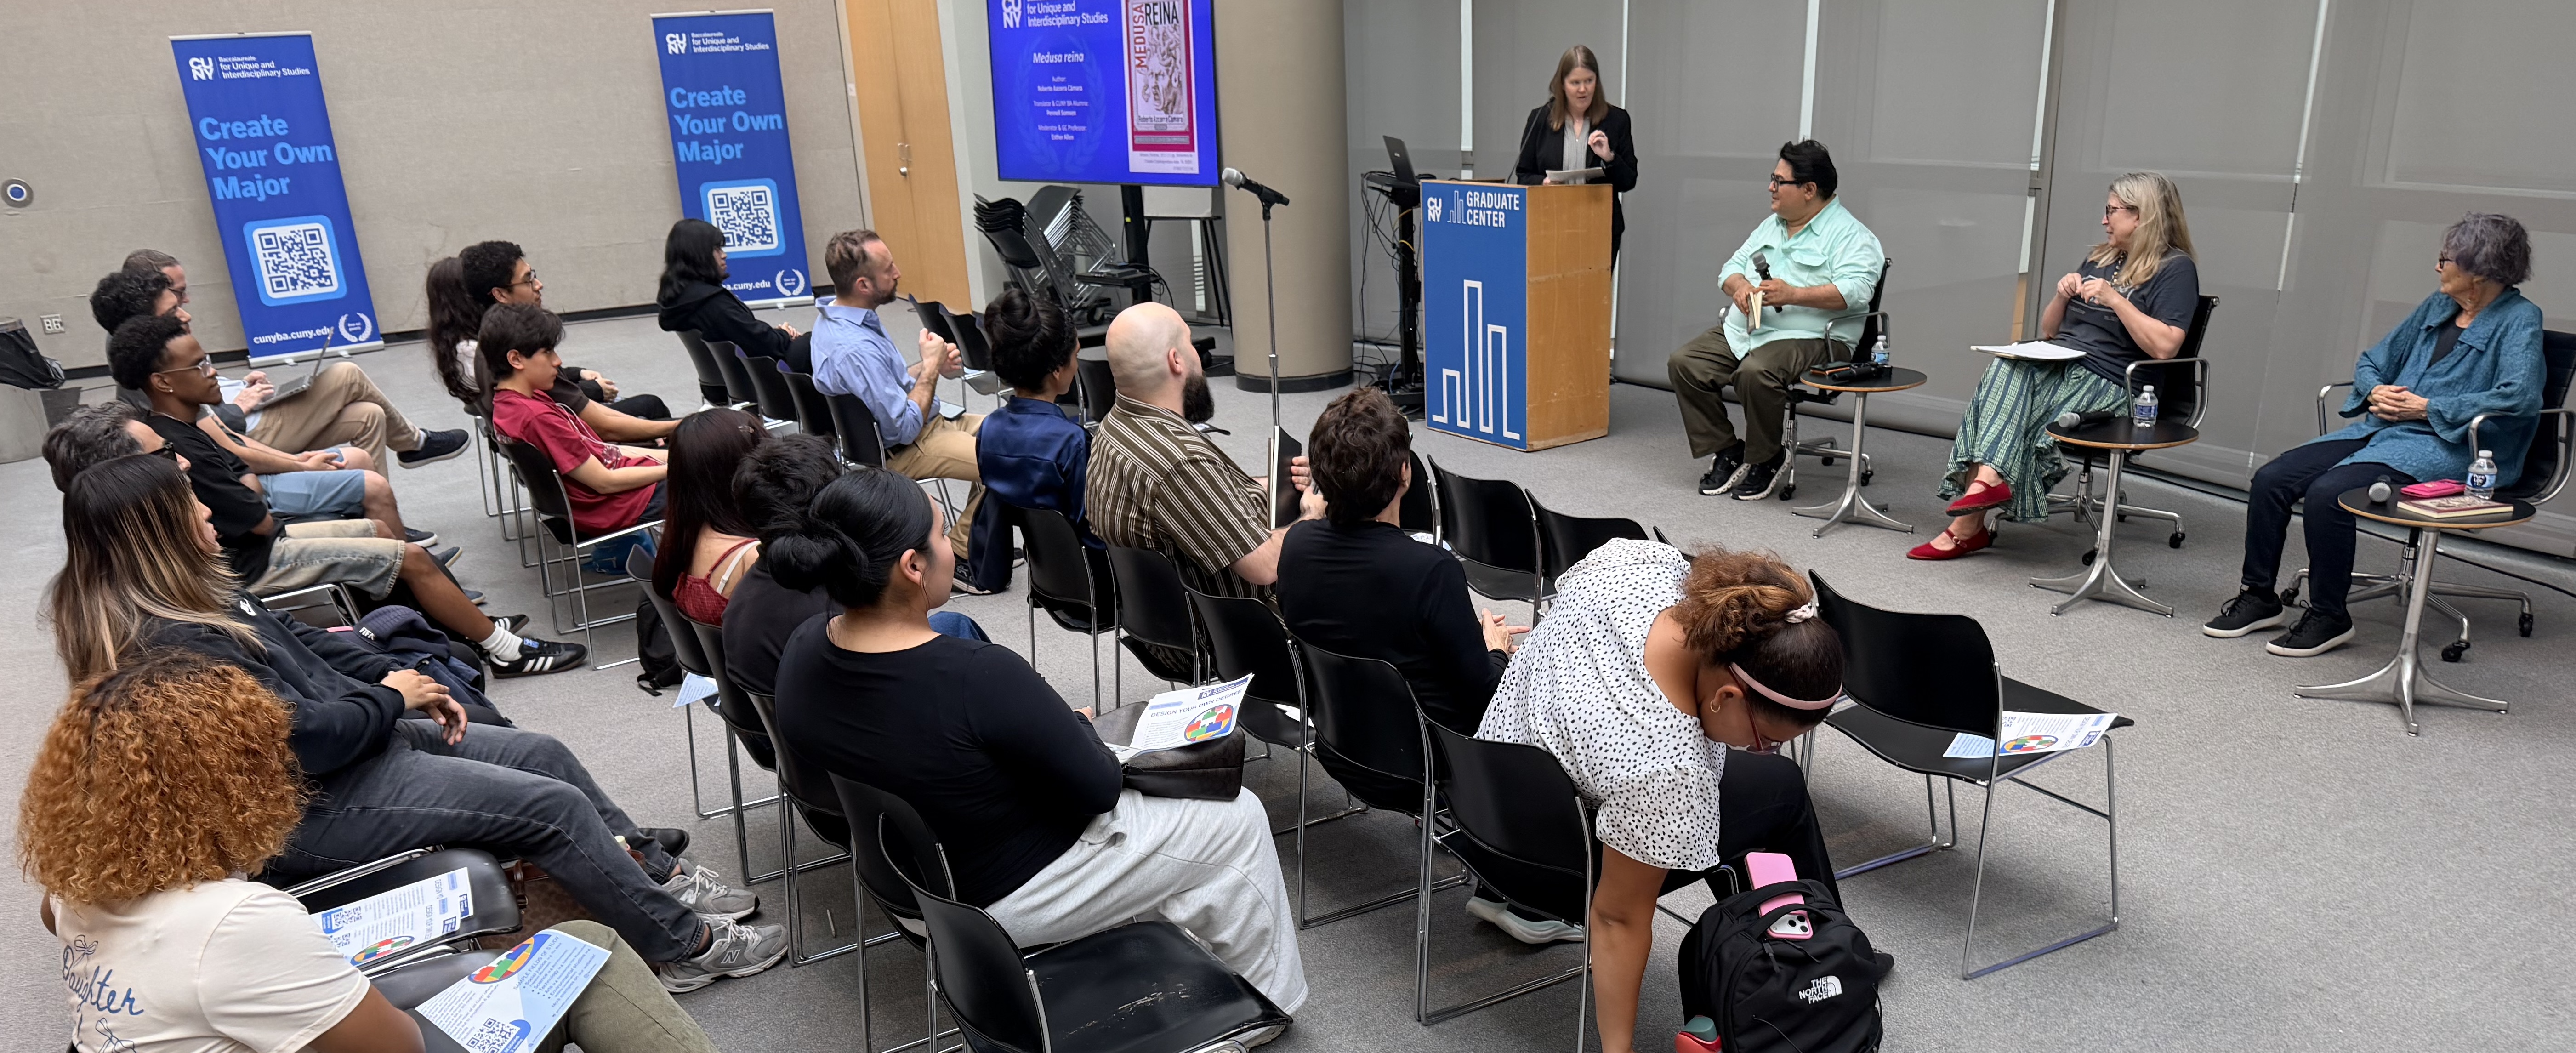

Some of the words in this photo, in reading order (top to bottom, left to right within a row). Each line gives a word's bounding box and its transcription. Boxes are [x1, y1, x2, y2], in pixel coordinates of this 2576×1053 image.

[1027, 4, 1036, 14] for
[1037, 3, 1061, 15] Unique
[1062, 0, 1075, 11] and
[1144, 1, 1179, 25] REINA
[1003, 11, 1022, 28] NY
[1027, 15, 1080, 28] Interdisciplinary
[1081, 12, 1108, 24] Studies
[666, 33, 686, 44] CU
[1132, 4, 1148, 68] MEDUSA
[667, 43, 686, 55] NY
[693, 44, 744, 53] Interdisciplinary
[745, 42, 769, 51] Studies
[189, 57, 213, 69] CU
[1033, 51, 1063, 63] Medusa
[1064, 51, 1084, 63] reina
[192, 68, 214, 80] NY
[222, 68, 281, 79] Interdisciplinary
[282, 68, 310, 76] Studies
[232, 62, 259, 70] Unique
[670, 85, 746, 108] Create
[199, 114, 289, 140] Create
[674, 114, 726, 135] Your
[732, 111, 782, 132] Own
[205, 147, 268, 170] Your
[274, 142, 333, 165] Own
[677, 139, 744, 165] Major
[212, 174, 290, 202] Major
[1427, 197, 1442, 210] CU
[1467, 191, 1519, 211] GRADUATE
[1428, 209, 1441, 222] NY
[1467, 209, 1505, 228] CENTER
[722, 279, 771, 290] a.cuny.edu
[359, 627, 376, 640] FIFA
[1179, 705, 1197, 713] YOUR
[1199, 699, 1214, 707] OWN
[1216, 689, 1244, 702] DEGREE
[512, 970, 530, 991] SAMPLE
[527, 956, 543, 973] FIELDS
[545, 935, 559, 951] STUDY
[721, 949, 741, 963] N
[62, 945, 144, 1015] Daughter
[524, 972, 537, 986] Social
[535, 959, 548, 974] justice
[539, 968, 559, 992] Technology
[549, 968, 574, 996] Environmental
[572, 953, 586, 968] studies
[533, 973, 548, 990] Science
[1811, 976, 1826, 988] THE
[1799, 984, 1827, 999] NORTH
[1808, 993, 1828, 1004] FACE
